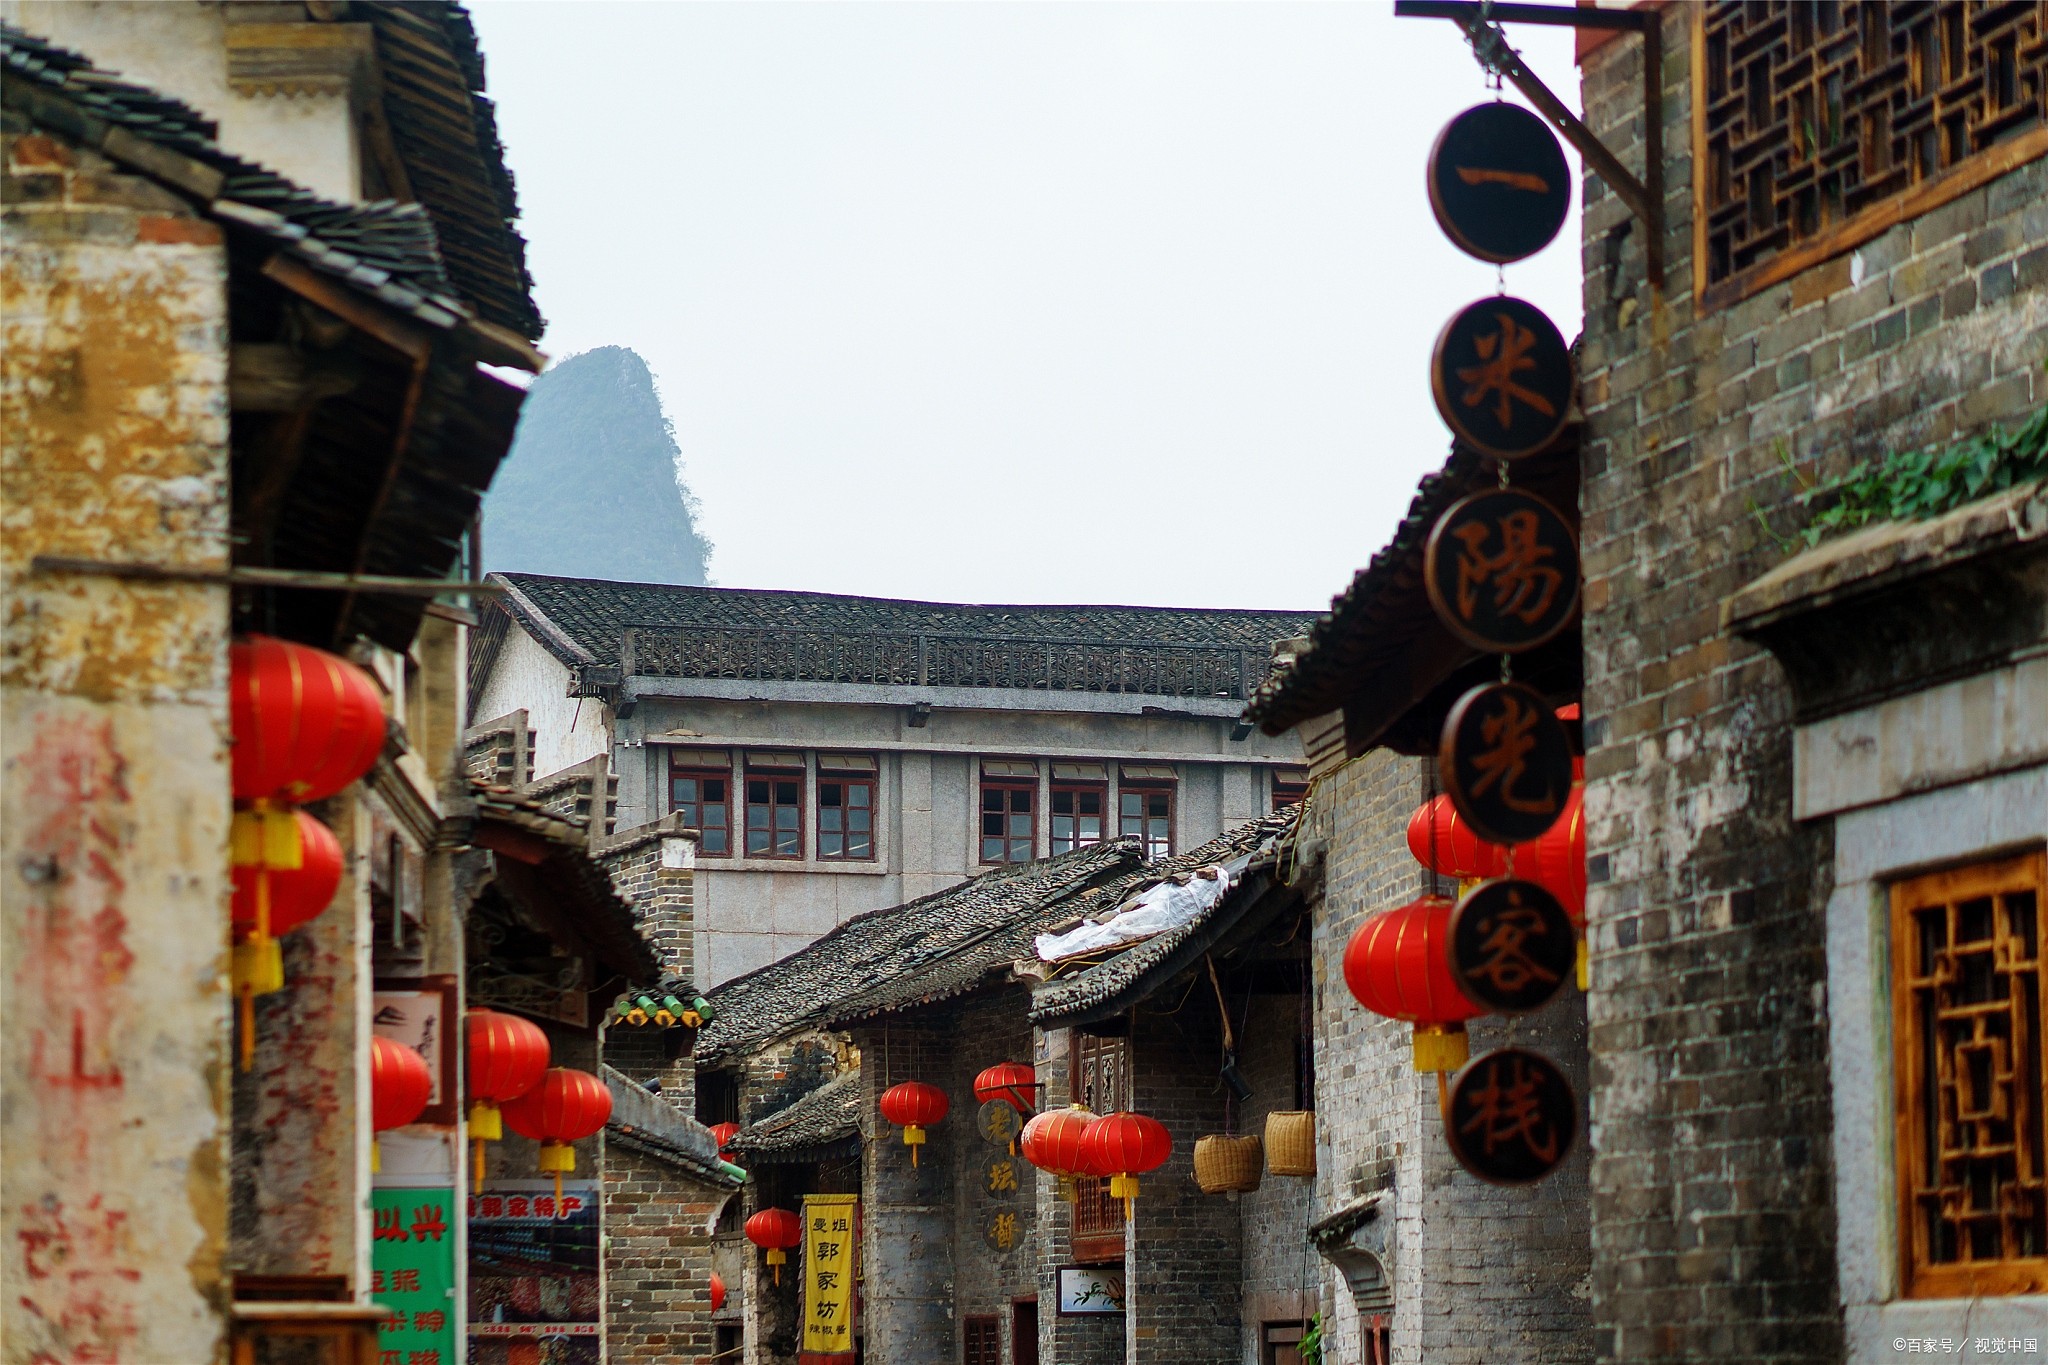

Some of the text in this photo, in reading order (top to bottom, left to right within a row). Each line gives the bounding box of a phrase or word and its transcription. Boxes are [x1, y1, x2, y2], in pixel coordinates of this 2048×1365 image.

[1451, 165, 1562, 1163] 一米陽光客栈
[813, 1218, 849, 1233] 曼姐
[817, 1242, 840, 1319] 郭家坊
